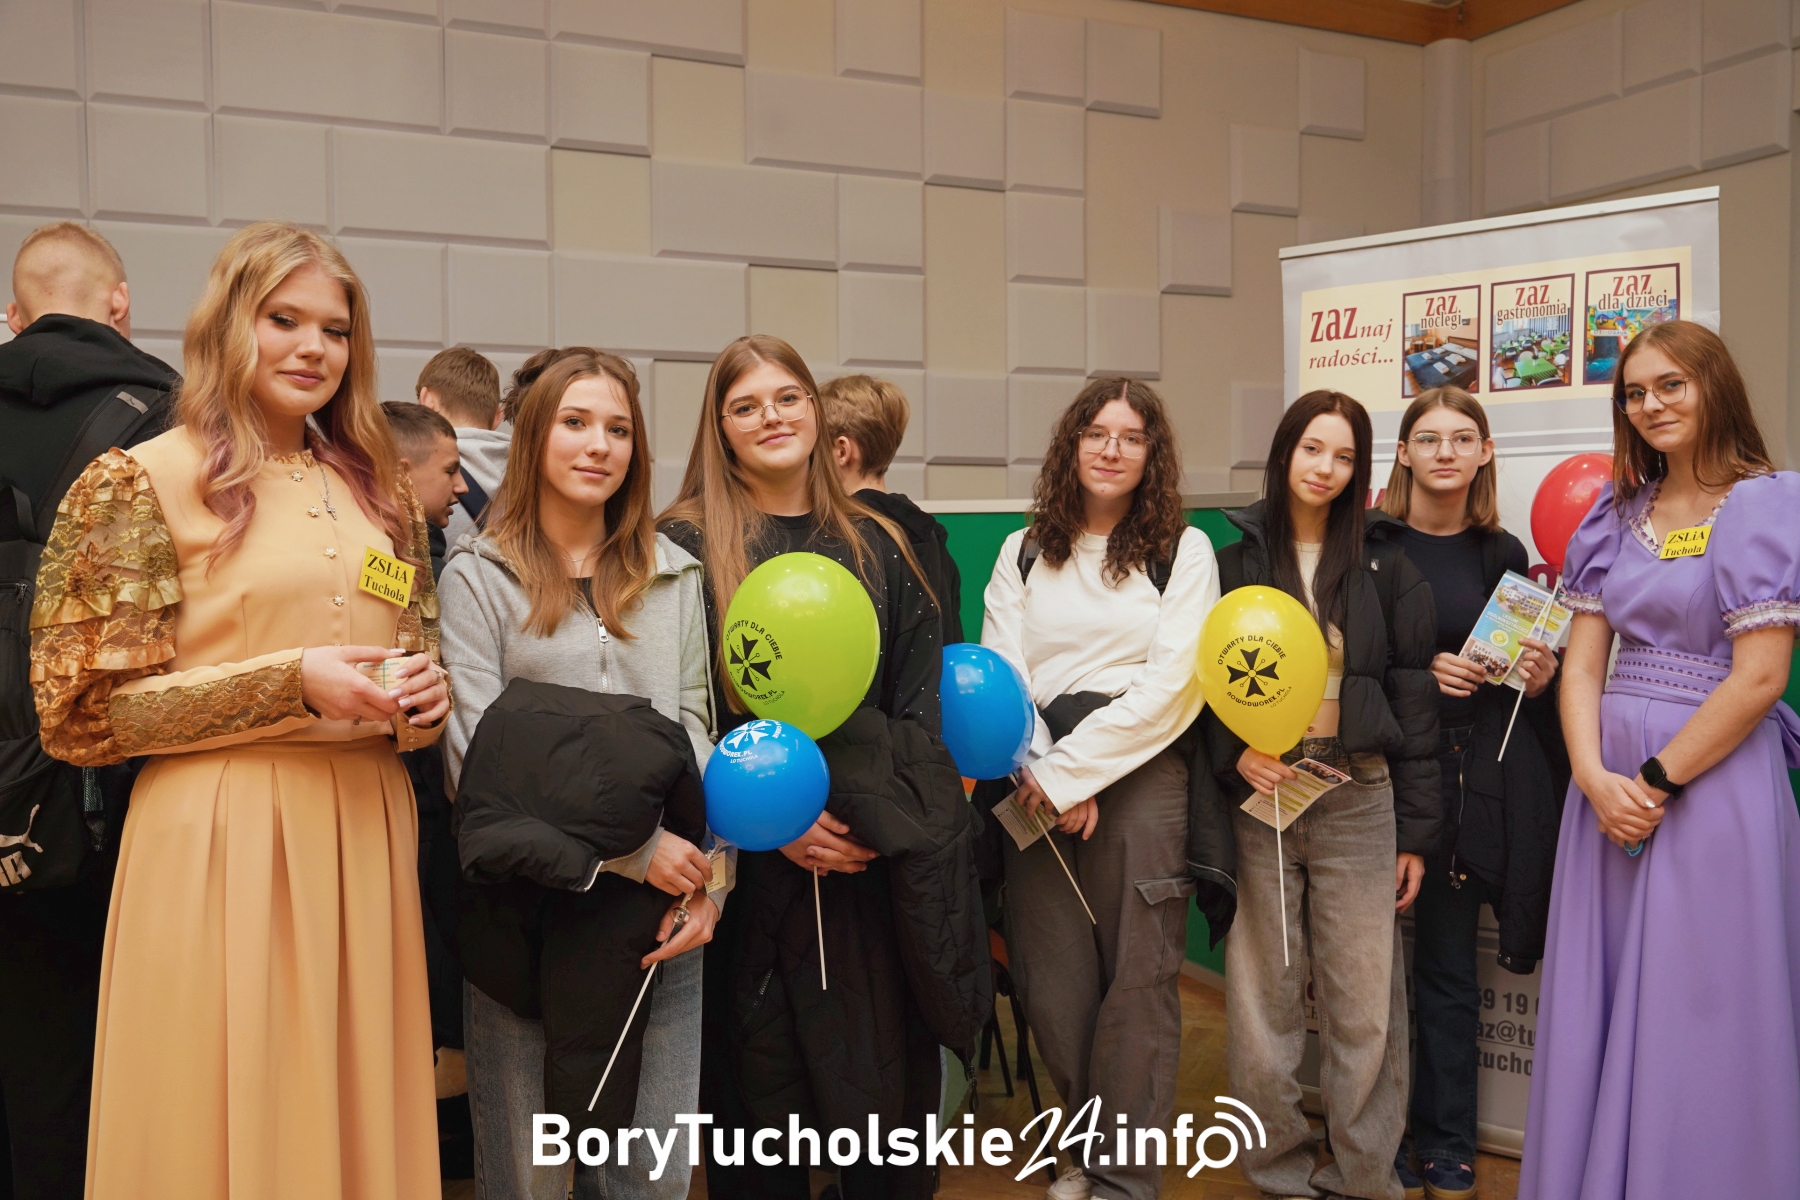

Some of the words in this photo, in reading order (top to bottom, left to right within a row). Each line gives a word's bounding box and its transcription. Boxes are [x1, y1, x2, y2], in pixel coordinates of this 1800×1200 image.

[1515, 284, 1550, 307] zaz
[1613, 273, 1653, 297] zaz
[1425, 295, 1458, 317] zaz
[1598, 293, 1620, 311] dla
[1626, 289, 1668, 309] dzieci
[1420, 310, 1462, 330] noclegi
[1496, 299, 1567, 325] gastronomia
[1308, 347, 1394, 369] radości...
[1667, 530, 1705, 544] ZSLiA
[1664, 545, 1702, 557] Tuchola
[367, 554, 408, 584] ZSLiA
[364, 574, 405, 602] Tuchola
[726, 620, 749, 641] OTWARTY
[750, 621, 765, 635] DLA
[764, 633, 783, 660] CIEBIE
[1217, 636, 1245, 665] OTWARTY
[1247, 635, 1264, 643] DLA
[1265, 638, 1287, 660] CIEBIE
[1502, 992, 1528, 1015] 19
